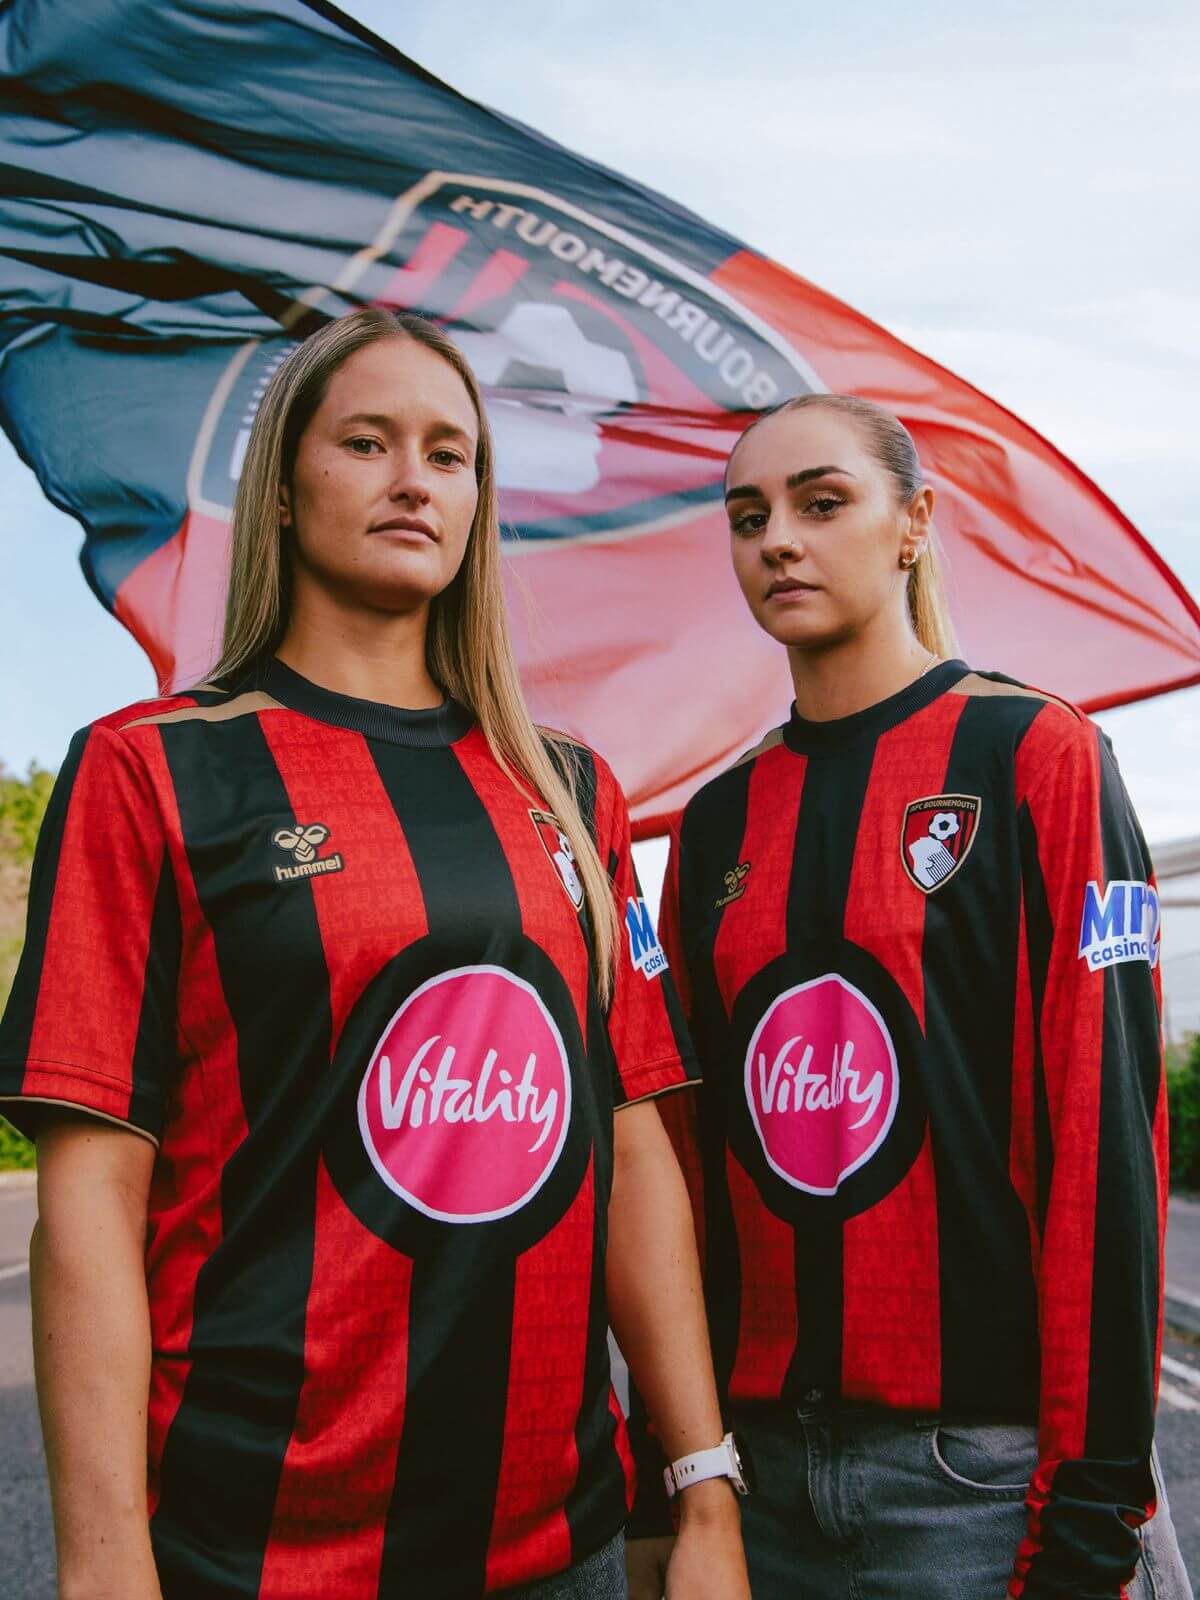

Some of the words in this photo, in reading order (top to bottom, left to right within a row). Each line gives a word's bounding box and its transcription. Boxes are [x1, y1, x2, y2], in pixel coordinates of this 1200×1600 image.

[924, 799, 976, 810] BOURNEMOUTH
[275, 855, 342, 881] hummel
[644, 948, 666, 973] casi
[379, 1035, 558, 1153] Vitality
[758, 1035, 884, 1130] Vitalty
